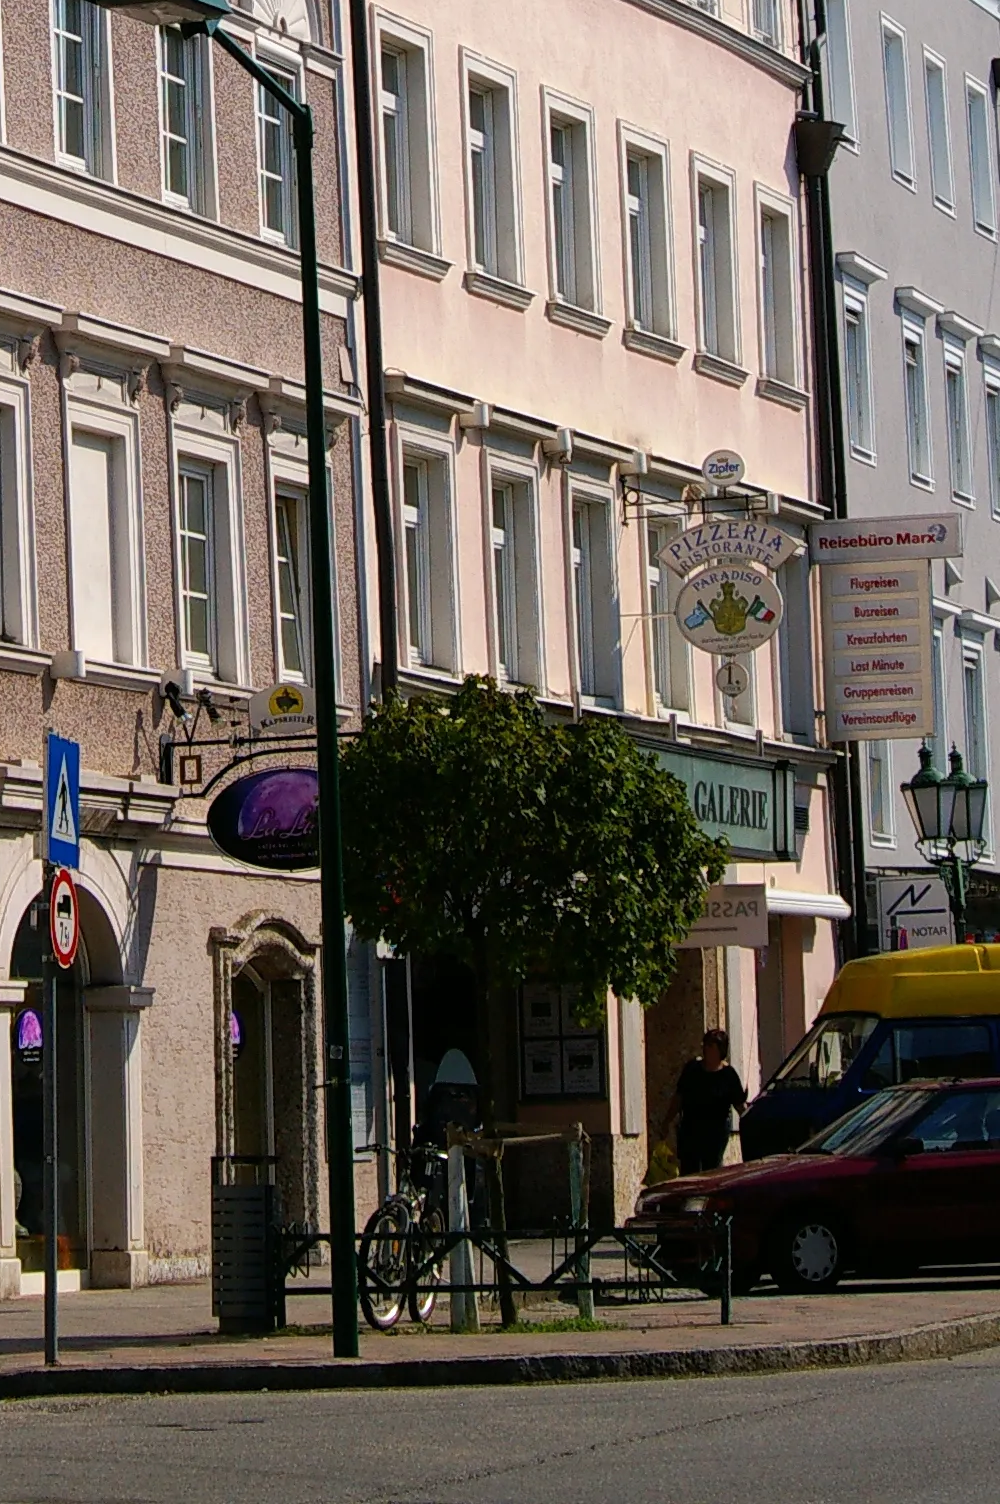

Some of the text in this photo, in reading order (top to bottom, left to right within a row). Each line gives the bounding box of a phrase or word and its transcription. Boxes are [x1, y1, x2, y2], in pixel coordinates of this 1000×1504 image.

[708, 462, 740, 476] Zipfer
[669, 522, 784, 561] PIZZERIA
[818, 531, 936, 549] Reisebüro Marx
[679, 541, 774, 575] RISTORANTE
[692, 570, 762, 592] PARADISO
[850, 576, 899, 591] Flugreisen
[854, 604, 899, 618] Busreisen
[846, 631, 908, 645] Kreuzfahrten
[851, 659, 904, 672] Last Minute
[843, 684, 914, 700] Gruppenreisen
[841, 711, 917, 725] Vereinsausflüge
[693, 780, 769, 830] GALERIE
[911, 926, 948, 937] NOTAR
